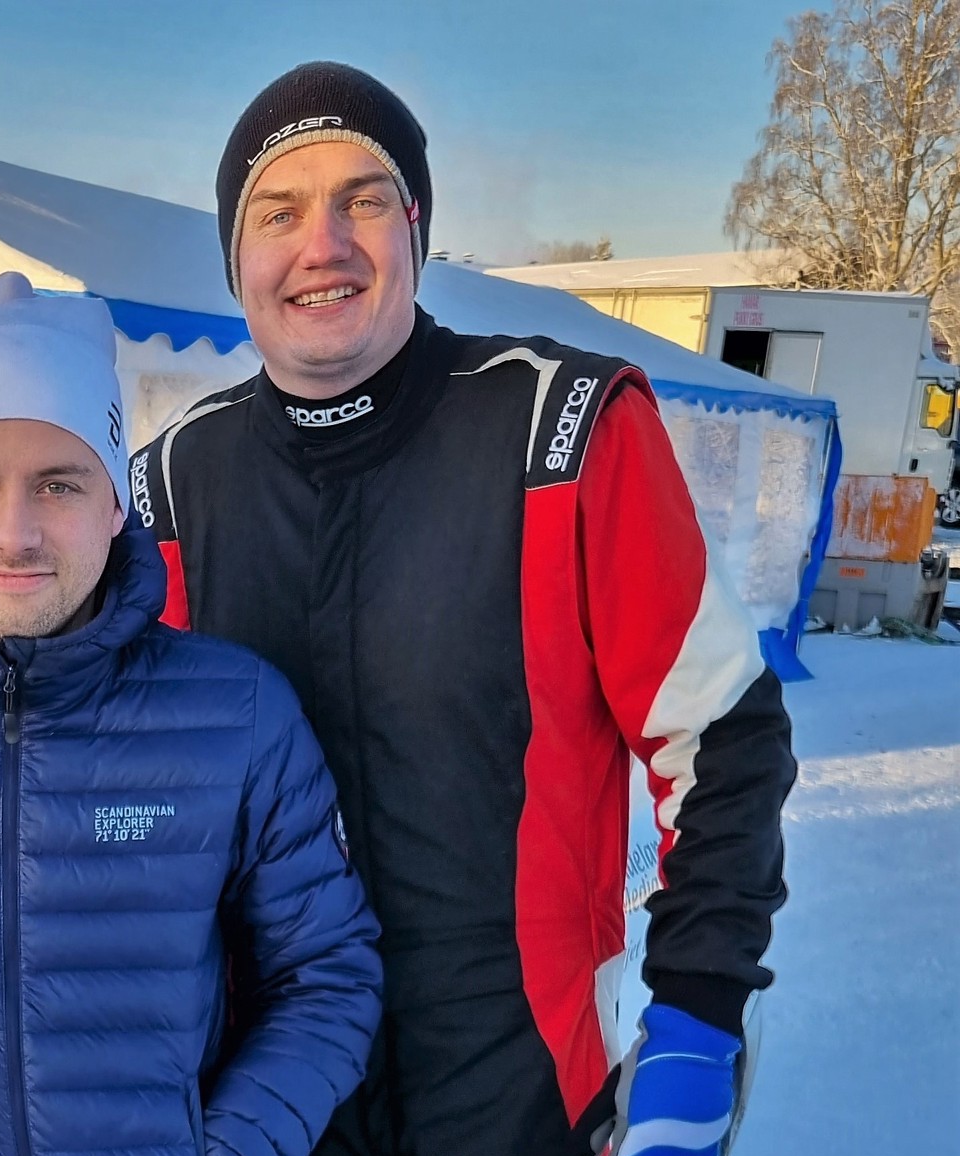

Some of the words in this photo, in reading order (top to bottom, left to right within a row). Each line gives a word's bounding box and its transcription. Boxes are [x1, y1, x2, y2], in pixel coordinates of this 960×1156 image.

[285, 395, 375, 427] sparco
[545, 377, 599, 472] sparco
[130, 452, 156, 529] sparco
[94, 805, 175, 819] SCANDINAVIAN
[94, 817, 154, 831] EXPLORER
